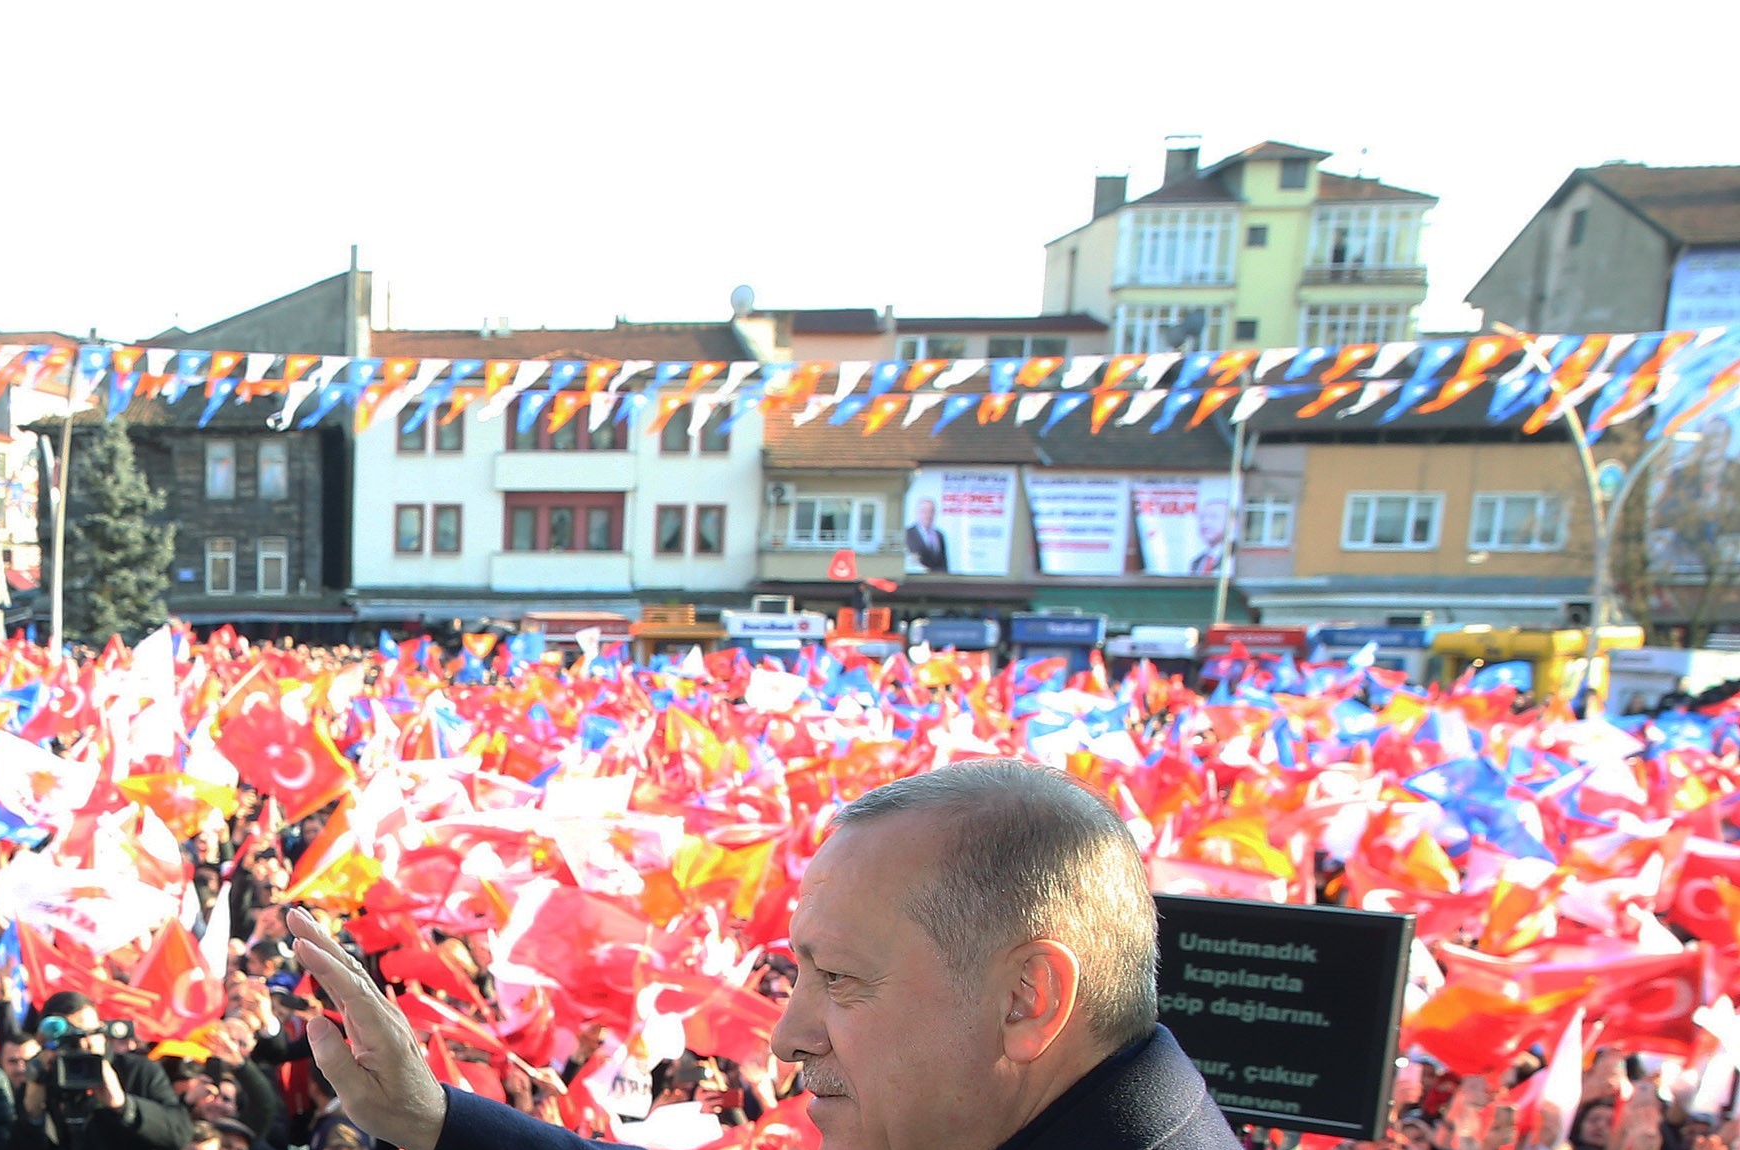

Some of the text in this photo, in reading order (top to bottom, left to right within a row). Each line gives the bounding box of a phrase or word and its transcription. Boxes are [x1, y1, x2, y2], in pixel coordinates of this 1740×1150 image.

[1178, 932, 1318, 963] Unutmadık
[1184, 964, 1303, 993] kapılarda
[1159, 992, 1330, 1027] çöp dağlarını.
[1243, 1065, 1319, 1088] çukur
[1208, 1087, 1301, 1114] lmeyen
